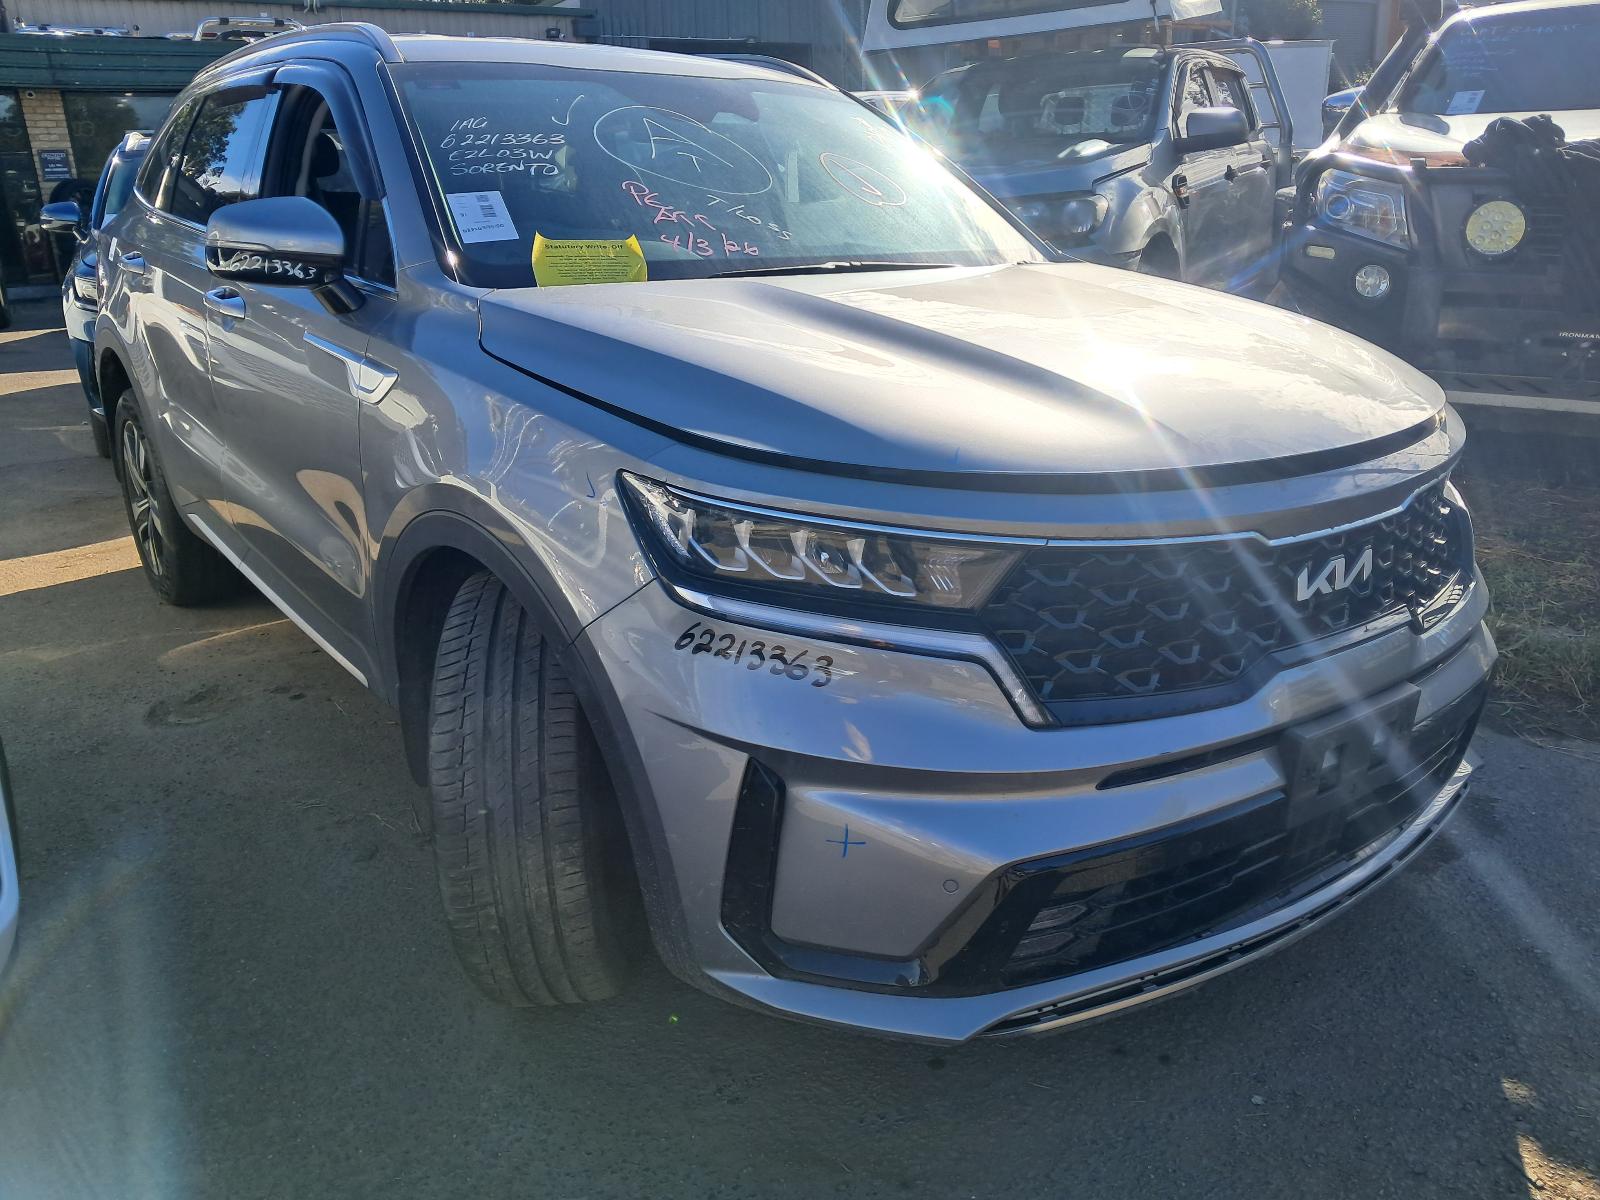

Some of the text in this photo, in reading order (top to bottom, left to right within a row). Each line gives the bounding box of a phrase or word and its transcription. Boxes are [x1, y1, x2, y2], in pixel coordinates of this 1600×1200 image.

[440, 133, 566, 149] 62213363
[449, 160, 559, 176] SORENTO
[229, 251, 317, 280] 62213363
[1297, 545, 1373, 601] KIA
[674, 621, 834, 688] 62213363
